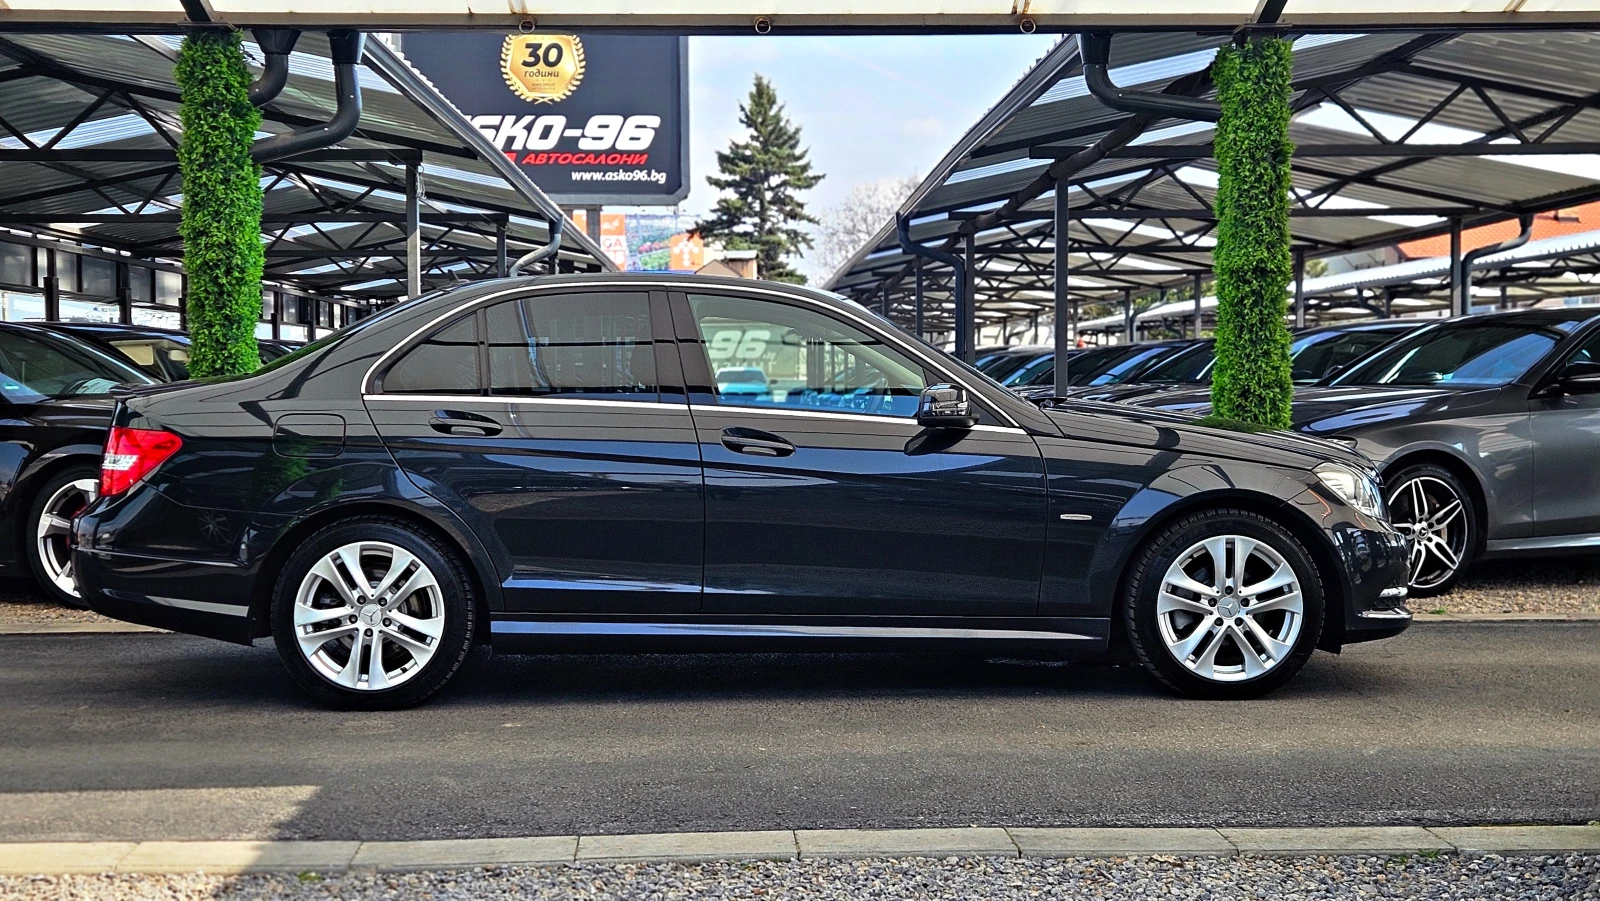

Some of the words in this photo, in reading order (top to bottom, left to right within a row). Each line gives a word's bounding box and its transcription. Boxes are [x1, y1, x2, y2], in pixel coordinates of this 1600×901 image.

[521, 43, 563, 68] 30
[524, 69, 560, 78] години
[464, 115, 661, 150] SKO-96
[521, 153, 649, 165] АВТОСАЛОНИ
[571, 169, 667, 184] www.asko96.bg
[706, 330, 771, 359] 96
